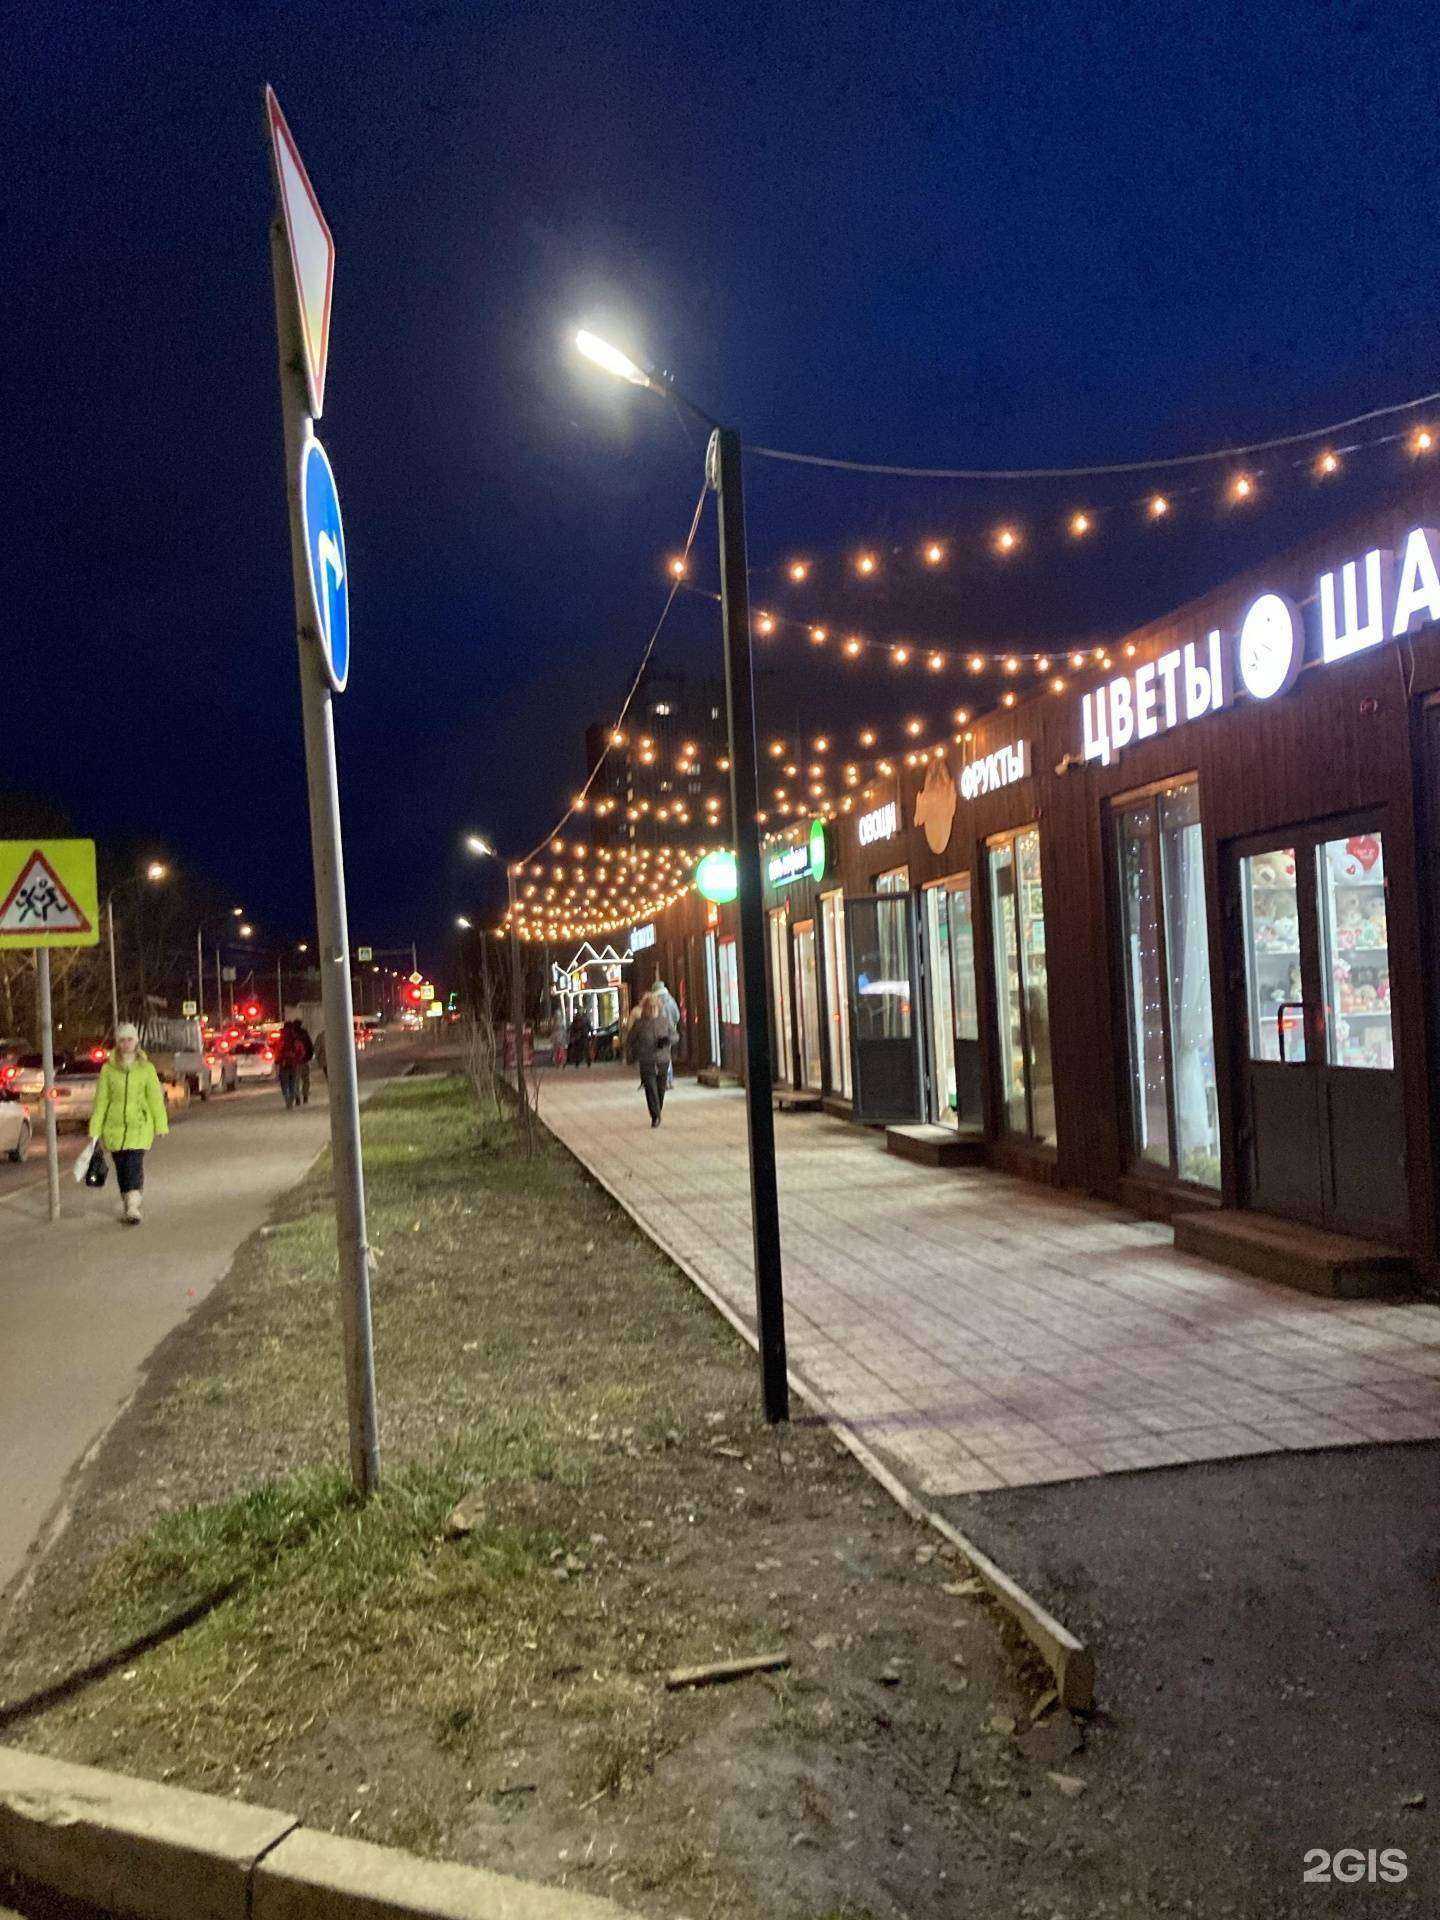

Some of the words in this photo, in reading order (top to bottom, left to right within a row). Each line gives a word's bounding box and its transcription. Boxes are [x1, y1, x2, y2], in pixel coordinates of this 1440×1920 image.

[1081, 629, 1224, 766] ЦВЕТЫ
[858, 801, 897, 847] ОВОЩИ
[960, 739, 1025, 800] ФРУКТЫ
